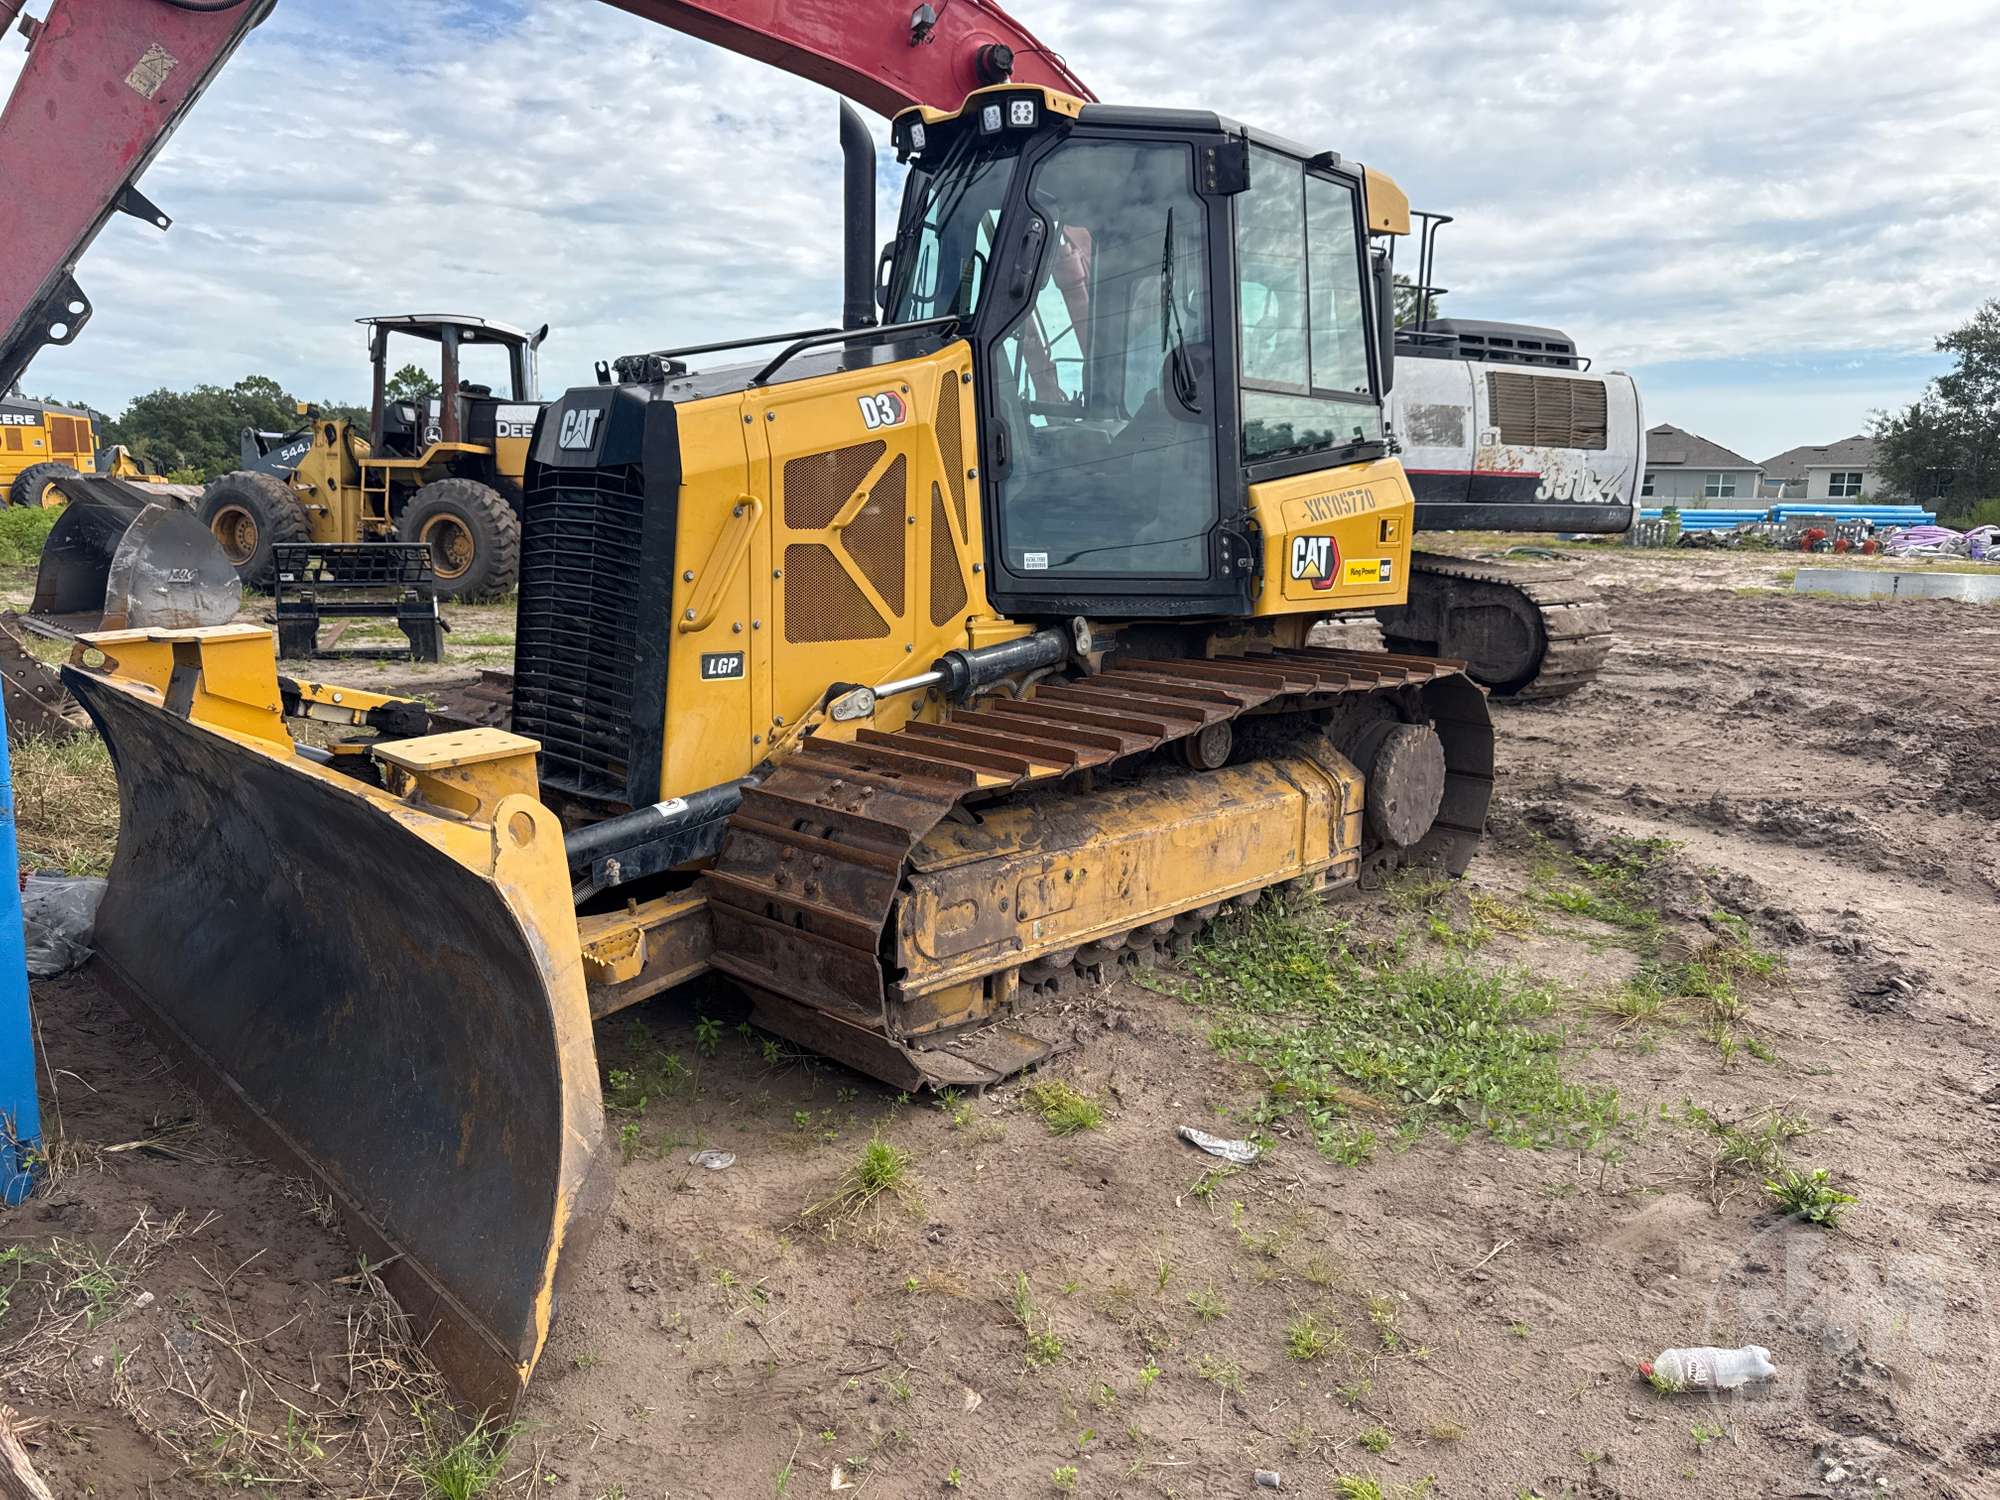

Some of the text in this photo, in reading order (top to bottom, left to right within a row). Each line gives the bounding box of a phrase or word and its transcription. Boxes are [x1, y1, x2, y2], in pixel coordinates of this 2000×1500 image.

[0, 414, 36, 425] ERE
[559, 409, 601, 449] CAT
[858, 393, 896, 429] D3
[1292, 537, 1331, 579] CAT
[708, 657, 739, 675] LGP
